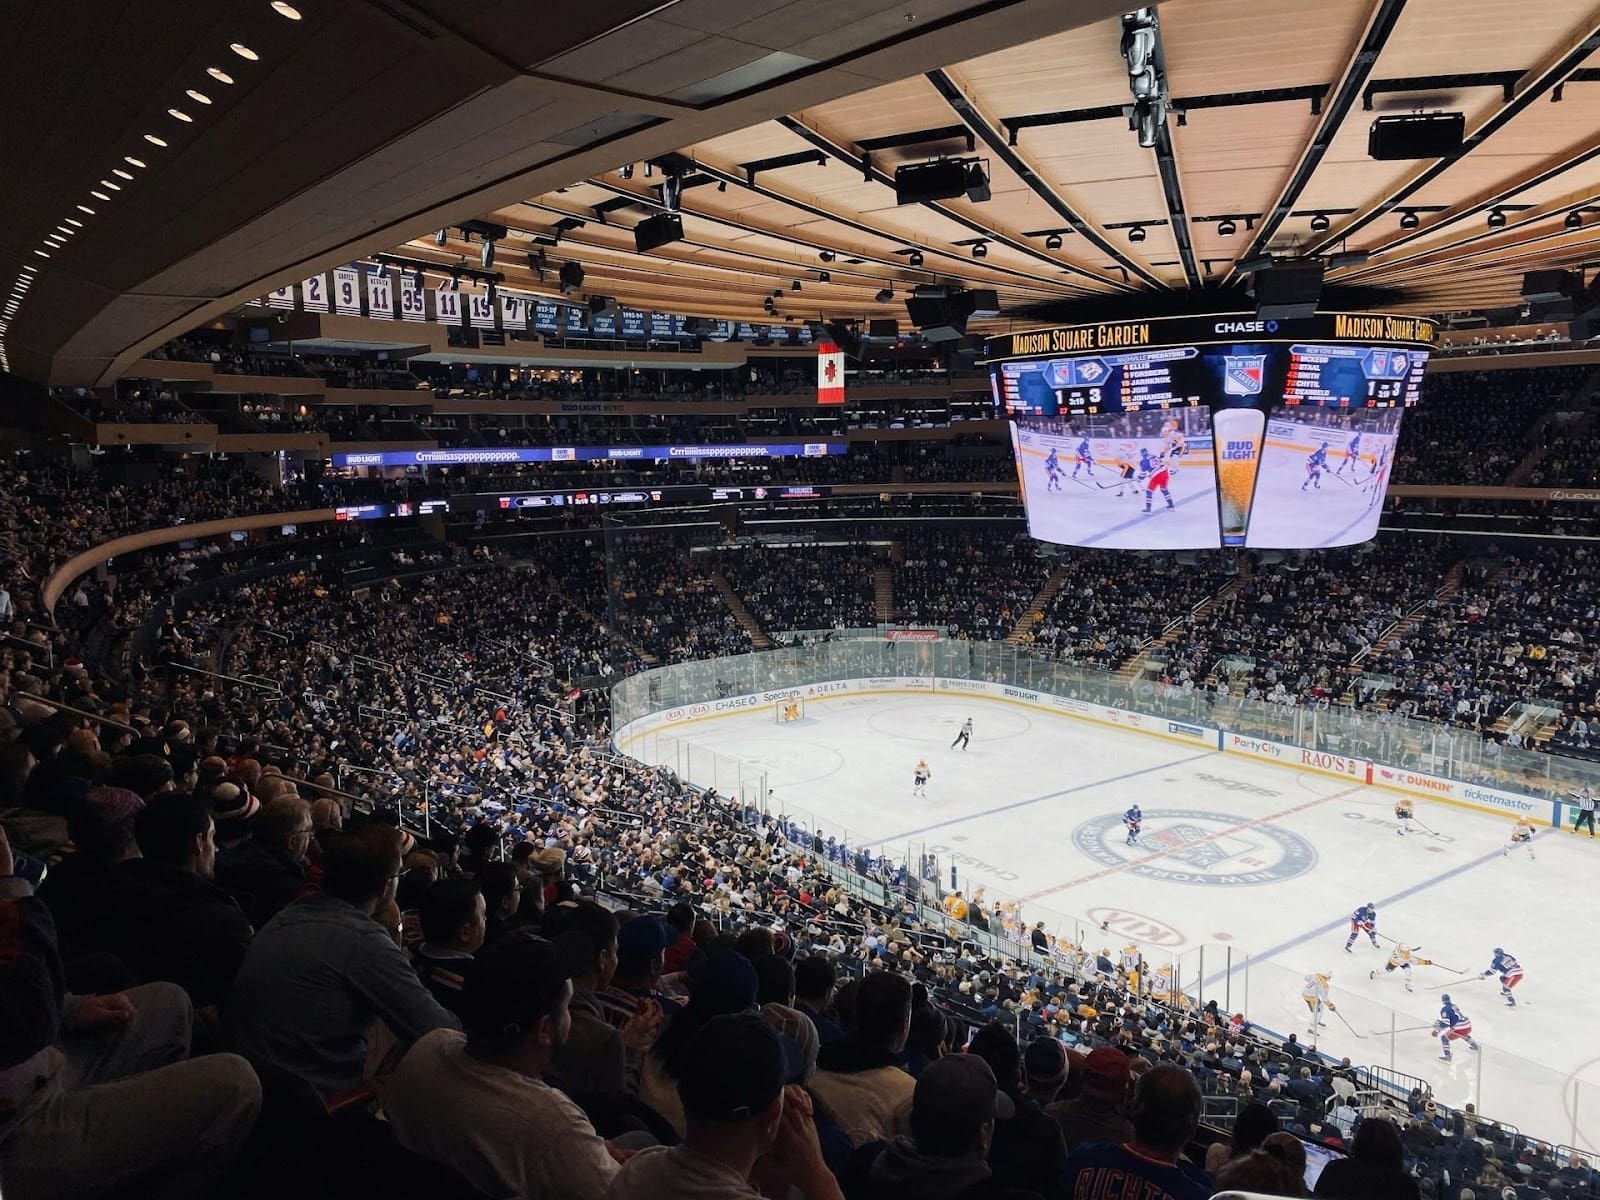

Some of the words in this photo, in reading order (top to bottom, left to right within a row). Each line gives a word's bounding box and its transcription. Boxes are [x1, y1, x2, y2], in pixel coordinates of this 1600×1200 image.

[309, 277, 321, 301] 2
[341, 282, 353, 305] 9
[373, 286, 389, 310] 11
[402, 289, 423, 312] 35
[440, 293, 457, 316] 11
[473, 296, 492, 318] 19
[1214, 321, 1265, 334] CHASE
[1335, 315, 1384, 339] MADISON
[1385, 318, 1415, 341] SQUARE
[1011, 332, 1050, 355] MADISON
[1052, 328, 1095, 351] SQUARE
[1097, 324, 1150, 347] GARDEN
[1147, 350, 1186, 360] PREDATORS
[1228, 360, 1243, 368] NEW
[1232, 369, 1260, 391] RANGERS
[1088, 388, 1101, 403] 3
[1367, 381, 1376, 396] 1
[1391, 381, 1401, 397] 3
[1055, 390, 1063, 405] 1
[609, 449, 623, 457] BUD
[623, 448, 642, 457] LIGHT
[1226, 441, 1254, 450] BUD
[347, 455, 362, 464] BUD
[362, 454, 381, 463] LIGHT
[1221, 450, 1257, 460] LIGHT
[889, 630, 936, 640] Budweiser
[817, 682, 848, 693] DELTA
[1004, 688, 1019, 697] BUD
[1019, 691, 1039, 701] LIGHT
[763, 689, 801, 702] Spectrum
[715, 698, 748, 711] CHASE
[1302, 749, 1345, 773] RAO'S
[1406, 774, 1454, 793] DUNKIN'
[1464, 788, 1535, 811] ticketmaster
[1135, 865, 1207, 884] YORK
[1219, 871, 1276, 885] NEW
[1073, 1167, 1176, 1200] RICHT
